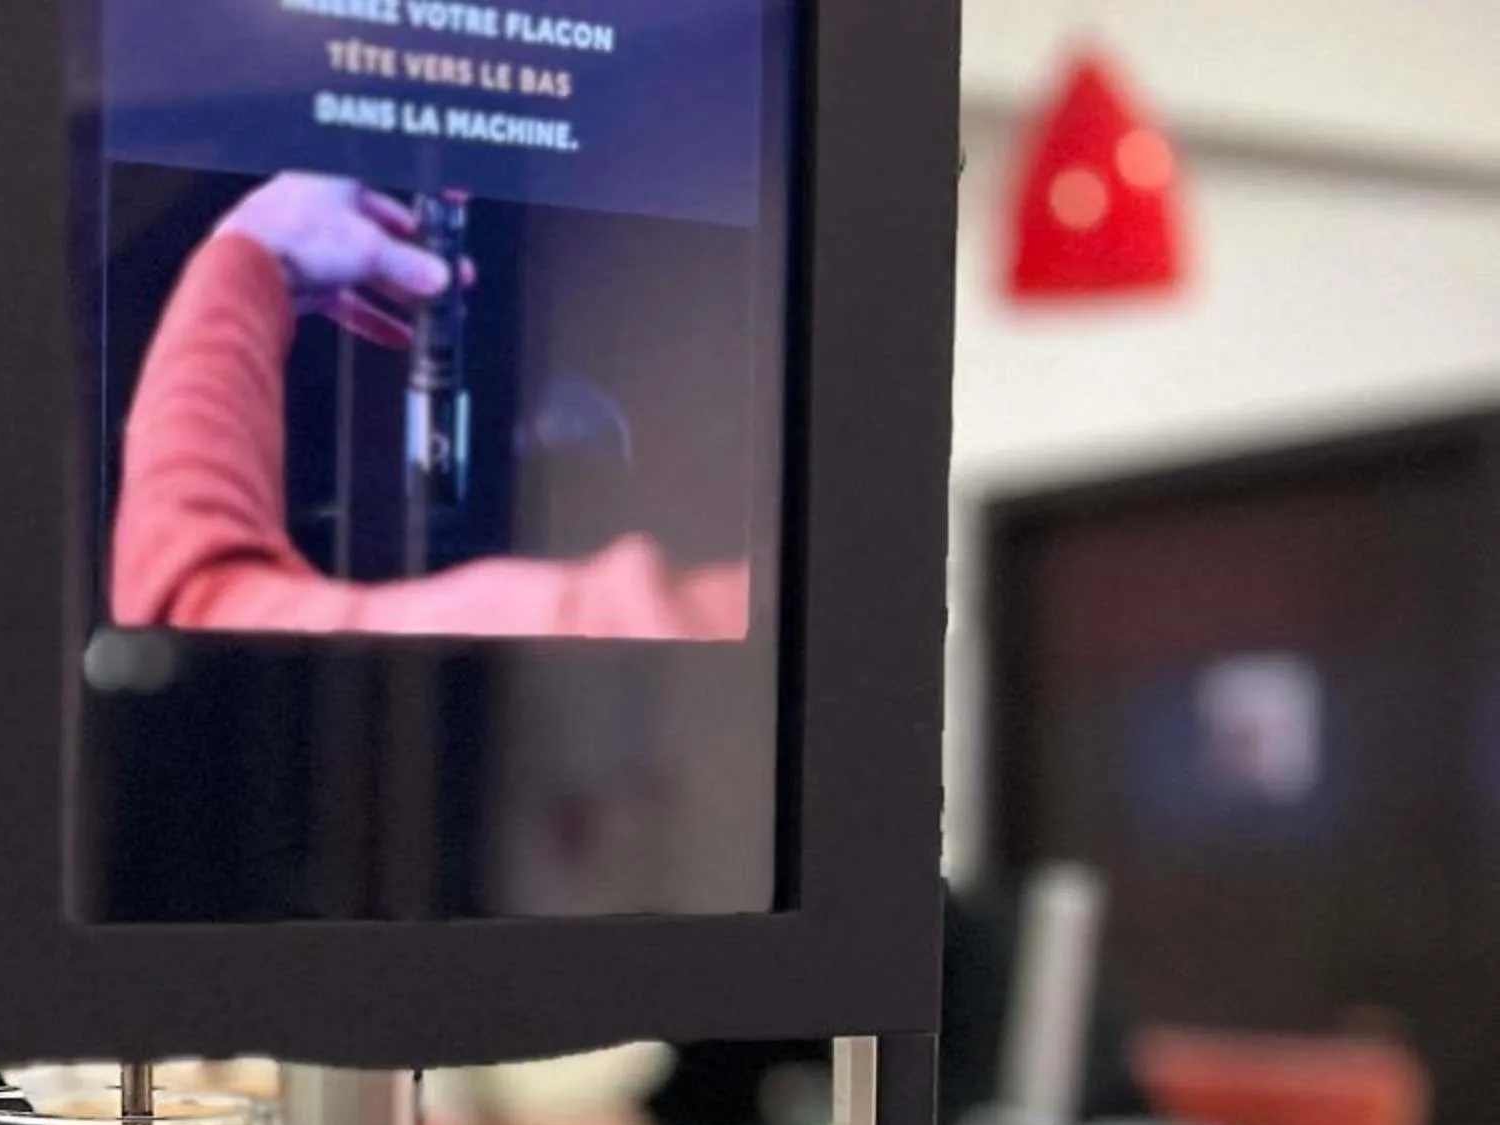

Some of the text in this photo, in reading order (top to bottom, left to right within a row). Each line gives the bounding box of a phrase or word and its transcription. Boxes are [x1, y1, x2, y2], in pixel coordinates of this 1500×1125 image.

[407, 2, 499, 36] VOTRE
[505, 13, 613, 50] FLACON
[327, 39, 571, 97] TÊTE VERS LE BAS
[315, 93, 579, 150] DANS LA MACHINE.
